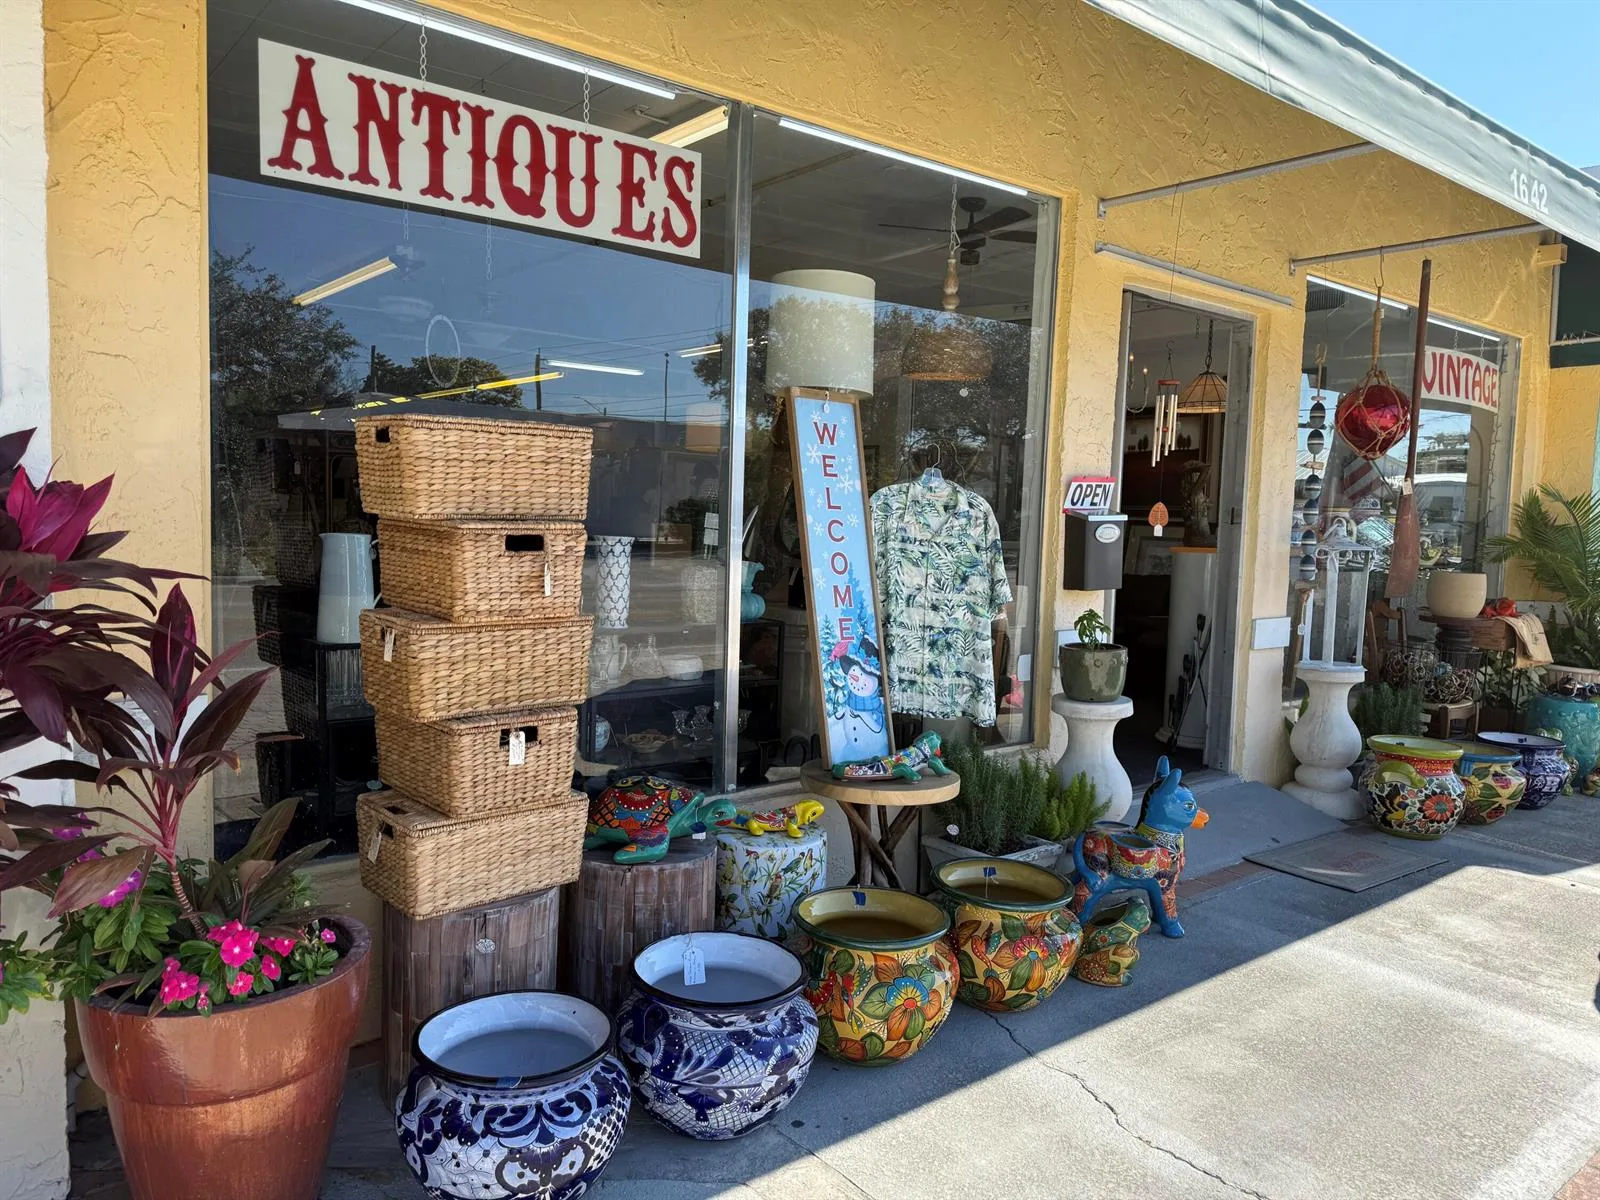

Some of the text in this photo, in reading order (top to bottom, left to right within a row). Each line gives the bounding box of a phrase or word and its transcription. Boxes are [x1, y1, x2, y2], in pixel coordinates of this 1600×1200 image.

[268, 54, 698, 248] ANTIQUES
[1510, 168, 1549, 214] 1642
[813, 421, 855, 641] WELCOME
[1070, 483, 1111, 507] OPEN
